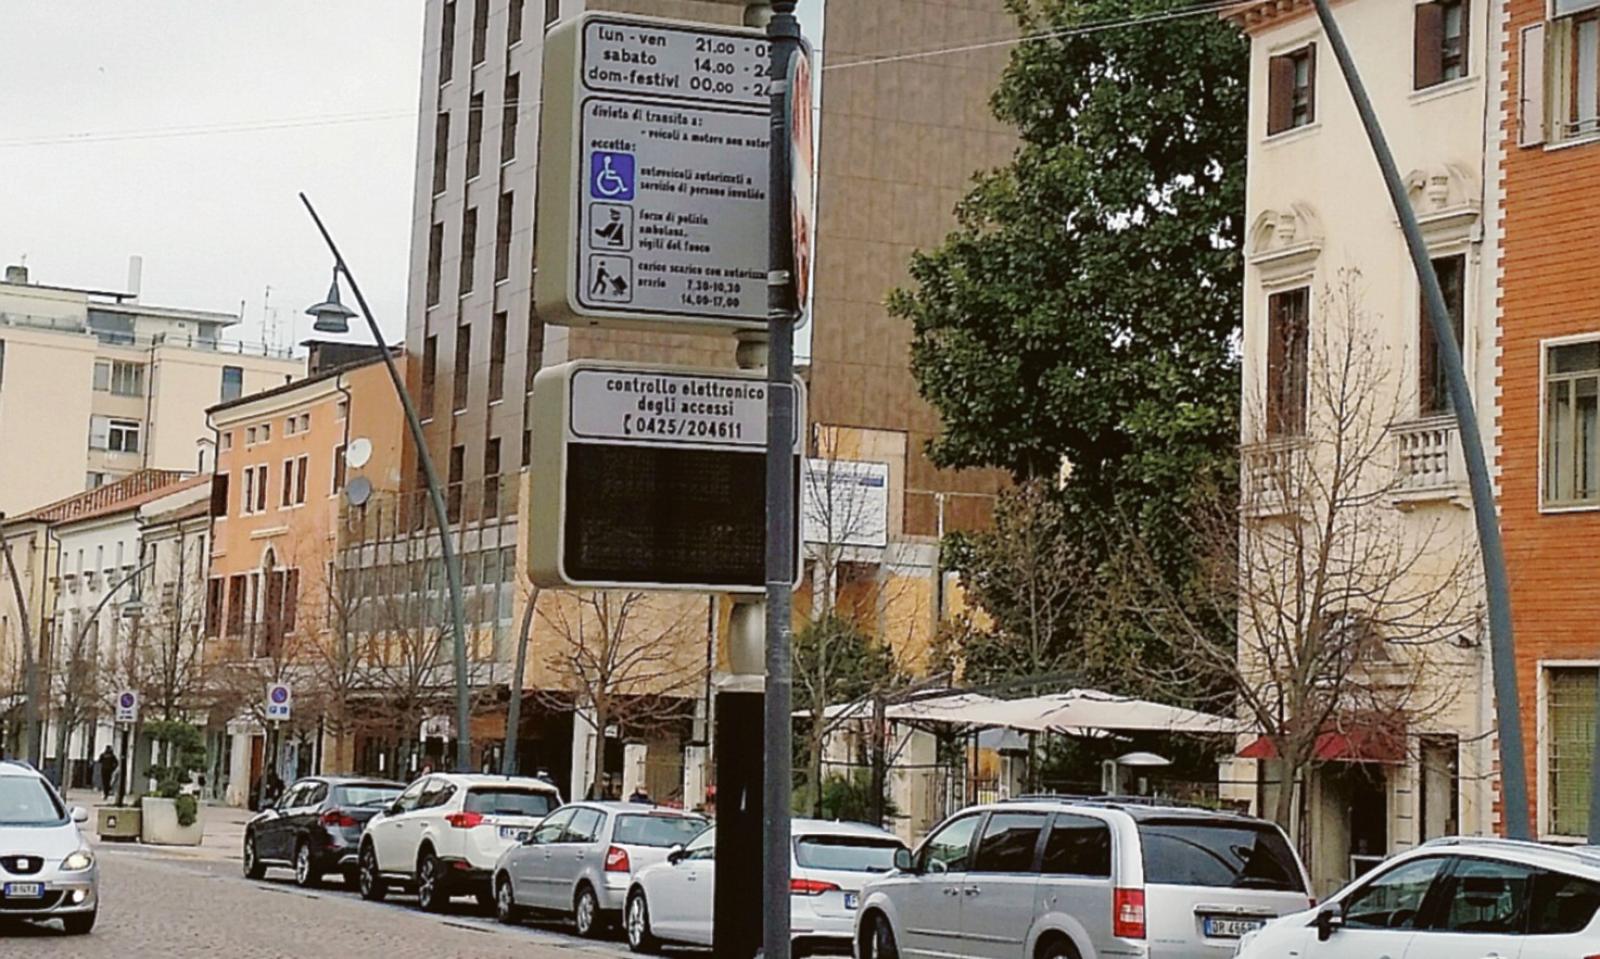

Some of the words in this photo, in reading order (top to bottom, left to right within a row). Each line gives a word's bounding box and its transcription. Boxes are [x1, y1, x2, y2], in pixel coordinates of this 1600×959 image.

[599, 27, 624, 42] lun
[640, 35, 666, 46] ven
[696, 38, 735, 54] 21.00
[604, 48, 657, 65] sabato
[695, 58, 734, 75] 14.00
[589, 66, 679, 88] dom-festivi
[592, 105, 628, 119] divieto
[633, 109, 642, 121] di
[646, 111, 688, 125] transito
[649, 129, 680, 140] veicoli
[692, 134, 724, 144] motore
[641, 181, 675, 192] servizio
[678, 183, 687, 192] di
[690, 185, 725, 196] persone
[666, 212, 675, 222] di
[678, 214, 708, 225] polizia
[639, 238, 663, 250] vigili
[667, 240, 681, 250] del
[685, 241, 710, 252] fuoco
[638, 262, 666, 272] carico
[670, 264, 702, 275] scarico
[705, 267, 721, 276] con
[607, 378, 677, 395] controllo
[682, 381, 765, 400] elettronico
[638, 397, 675, 416] degli
[682, 401, 734, 416] accessi
[636, 417, 741, 438] 0425/204611
